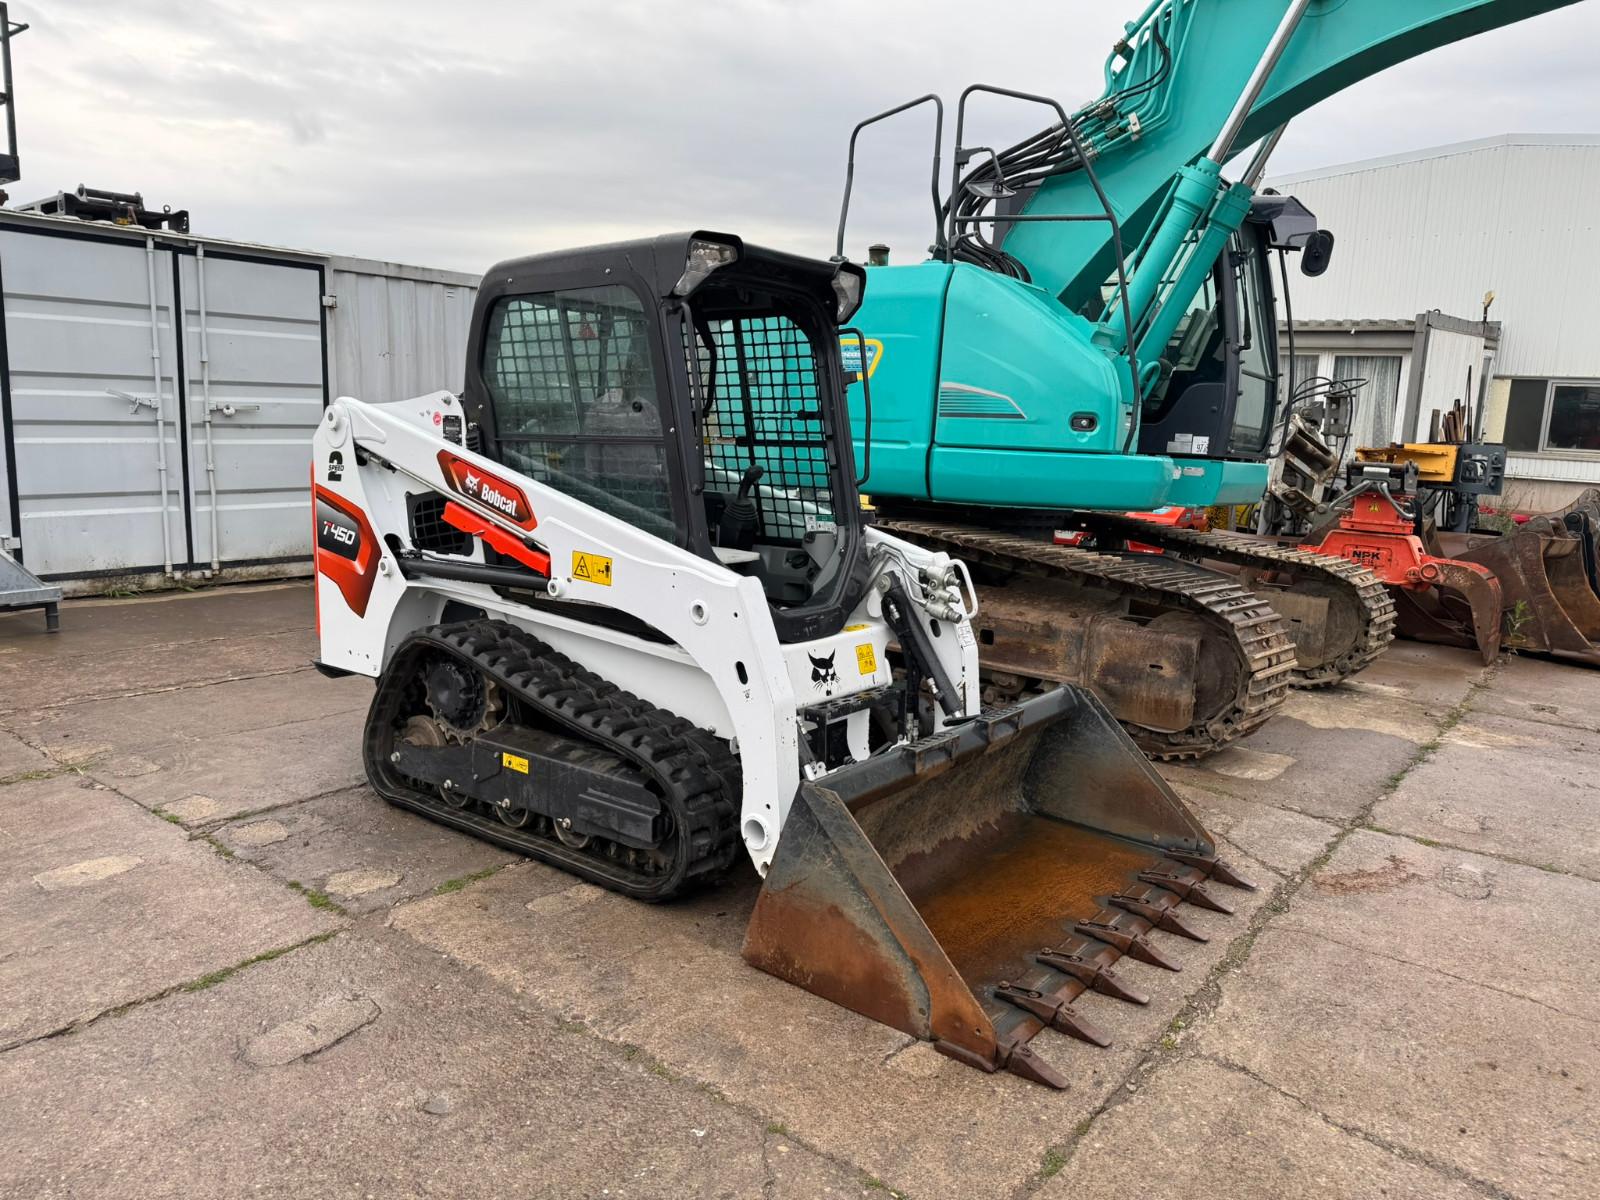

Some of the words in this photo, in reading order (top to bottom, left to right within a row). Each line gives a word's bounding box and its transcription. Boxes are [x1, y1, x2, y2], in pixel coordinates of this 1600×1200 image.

[327, 451, 343, 481] 2
[481, 483, 517, 516] Bobcat
[323, 521, 355, 545] T450
[1352, 550, 1380, 560] NPK
